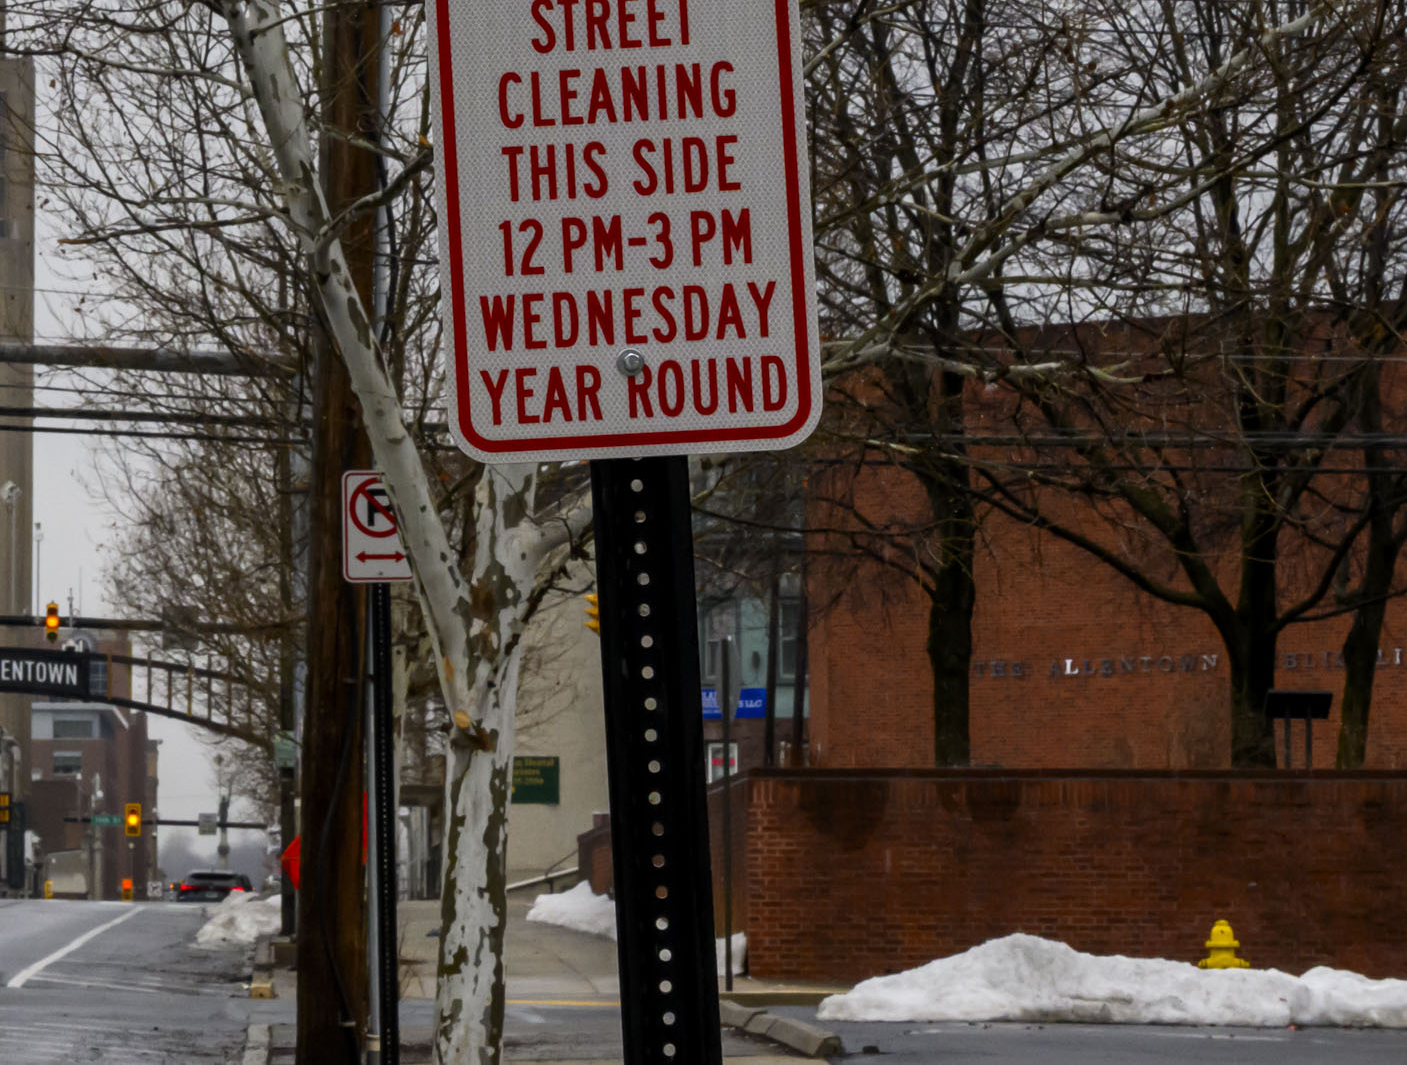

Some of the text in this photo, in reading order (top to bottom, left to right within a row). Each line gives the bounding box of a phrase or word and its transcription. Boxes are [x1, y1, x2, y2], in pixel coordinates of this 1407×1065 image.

[498, 61, 737, 130] CLEANING
[501, 135, 742, 203] THIS SIDE
[499, 219, 545, 277] 12
[690, 207, 753, 267] PM
[479, 281, 777, 352] WEDNESDAY
[480, 355, 788, 426] YEAR ROUND
[974, 660, 1025, 677] THE
[1049, 654, 1219, 677] ALLENTOWN
